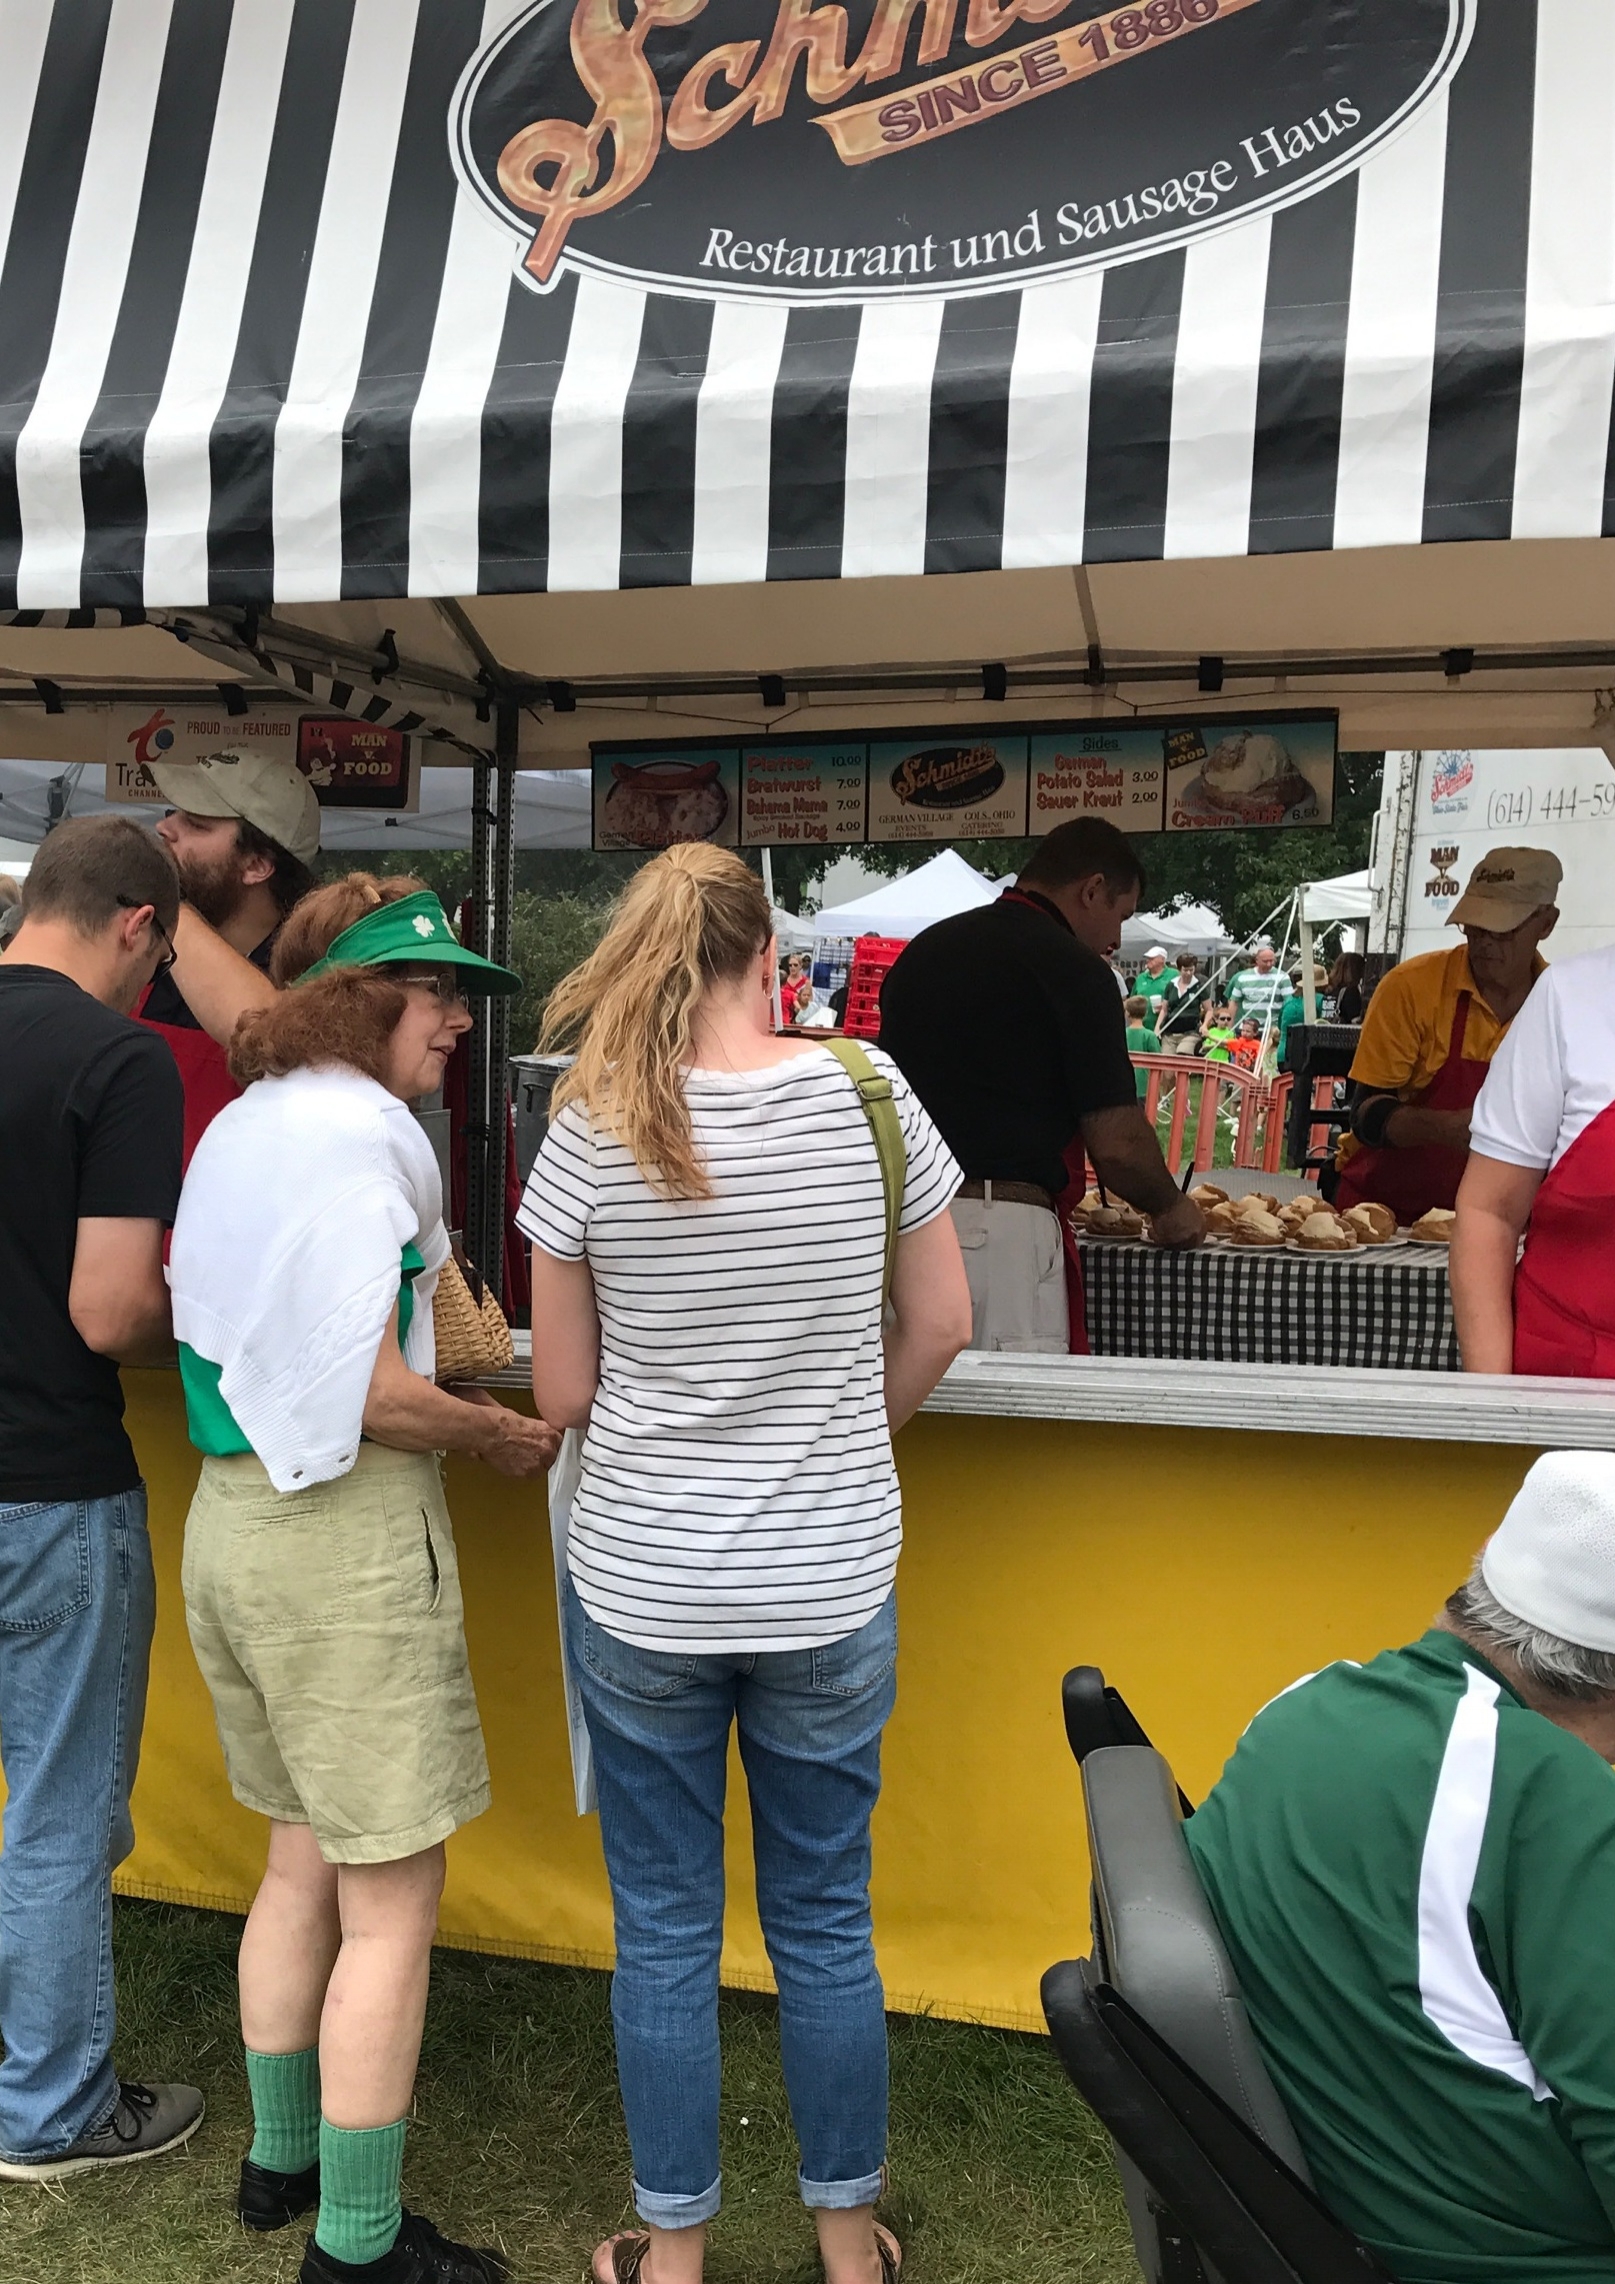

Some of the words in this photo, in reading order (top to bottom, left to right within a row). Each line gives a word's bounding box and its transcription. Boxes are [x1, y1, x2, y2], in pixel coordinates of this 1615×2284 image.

[878, 40, 1067, 143] SINCE
[1078, 0, 1219, 62] 1886
[699, 227, 938, 279] Restaurant
[950, 210, 1046, 274] und
[1056, 158, 1238, 247] Sausage
[1239, 96, 1362, 179] Haus
[187, 721, 220, 736] PROUD
[223, 726, 232, 736] TO
[233, 726, 241, 736] BE
[243, 722, 291, 737] FEATURED
[351, 732, 388, 748] MAN
[1082, 736, 1119, 751] Sides
[1168, 731, 1195, 748] MAN
[746, 755, 814, 773] Platter
[831, 756, 861, 767] 10.00
[1054, 752, 1107, 771] German
[1168, 747, 1206, 767] FOOD
[343, 761, 393, 776] FOOD
[895, 741, 997, 806] Schmidt's
[746, 776, 821, 794] Bratwurst
[836, 778, 861, 790] 7.00
[1037, 772, 1082, 790] Potato
[1086, 767, 1124, 788] Salad
[1132, 771, 1159, 783] 3.00
[746, 797, 791, 816] Bahama
[793, 796, 829, 813] Mama
[836, 799, 861, 811] 7.00
[1036, 791, 1080, 811] Sauer
[1083, 790, 1124, 808] Kraut
[1132, 792, 1158, 804] 2.00
[1487, 786, 1533, 830] (614)
[879, 814, 916, 825] GERMAN
[917, 813, 954, 823] VILLAGE
[992, 810, 1016, 820] OHIO
[961, 821, 1003, 830] CATERING
[1171, 810, 1236, 828] Cream
[1242, 805, 1287, 825] Puff
[1292, 808, 1320, 821] 6.50
[746, 824, 775, 840] Jumbo
[777, 822, 801, 839] Hot
[803, 821, 829, 842] Dog
[836, 821, 861, 833] 4.00
[1430, 846, 1460, 863] MAN
[1424, 881, 1460, 897] FOOD
